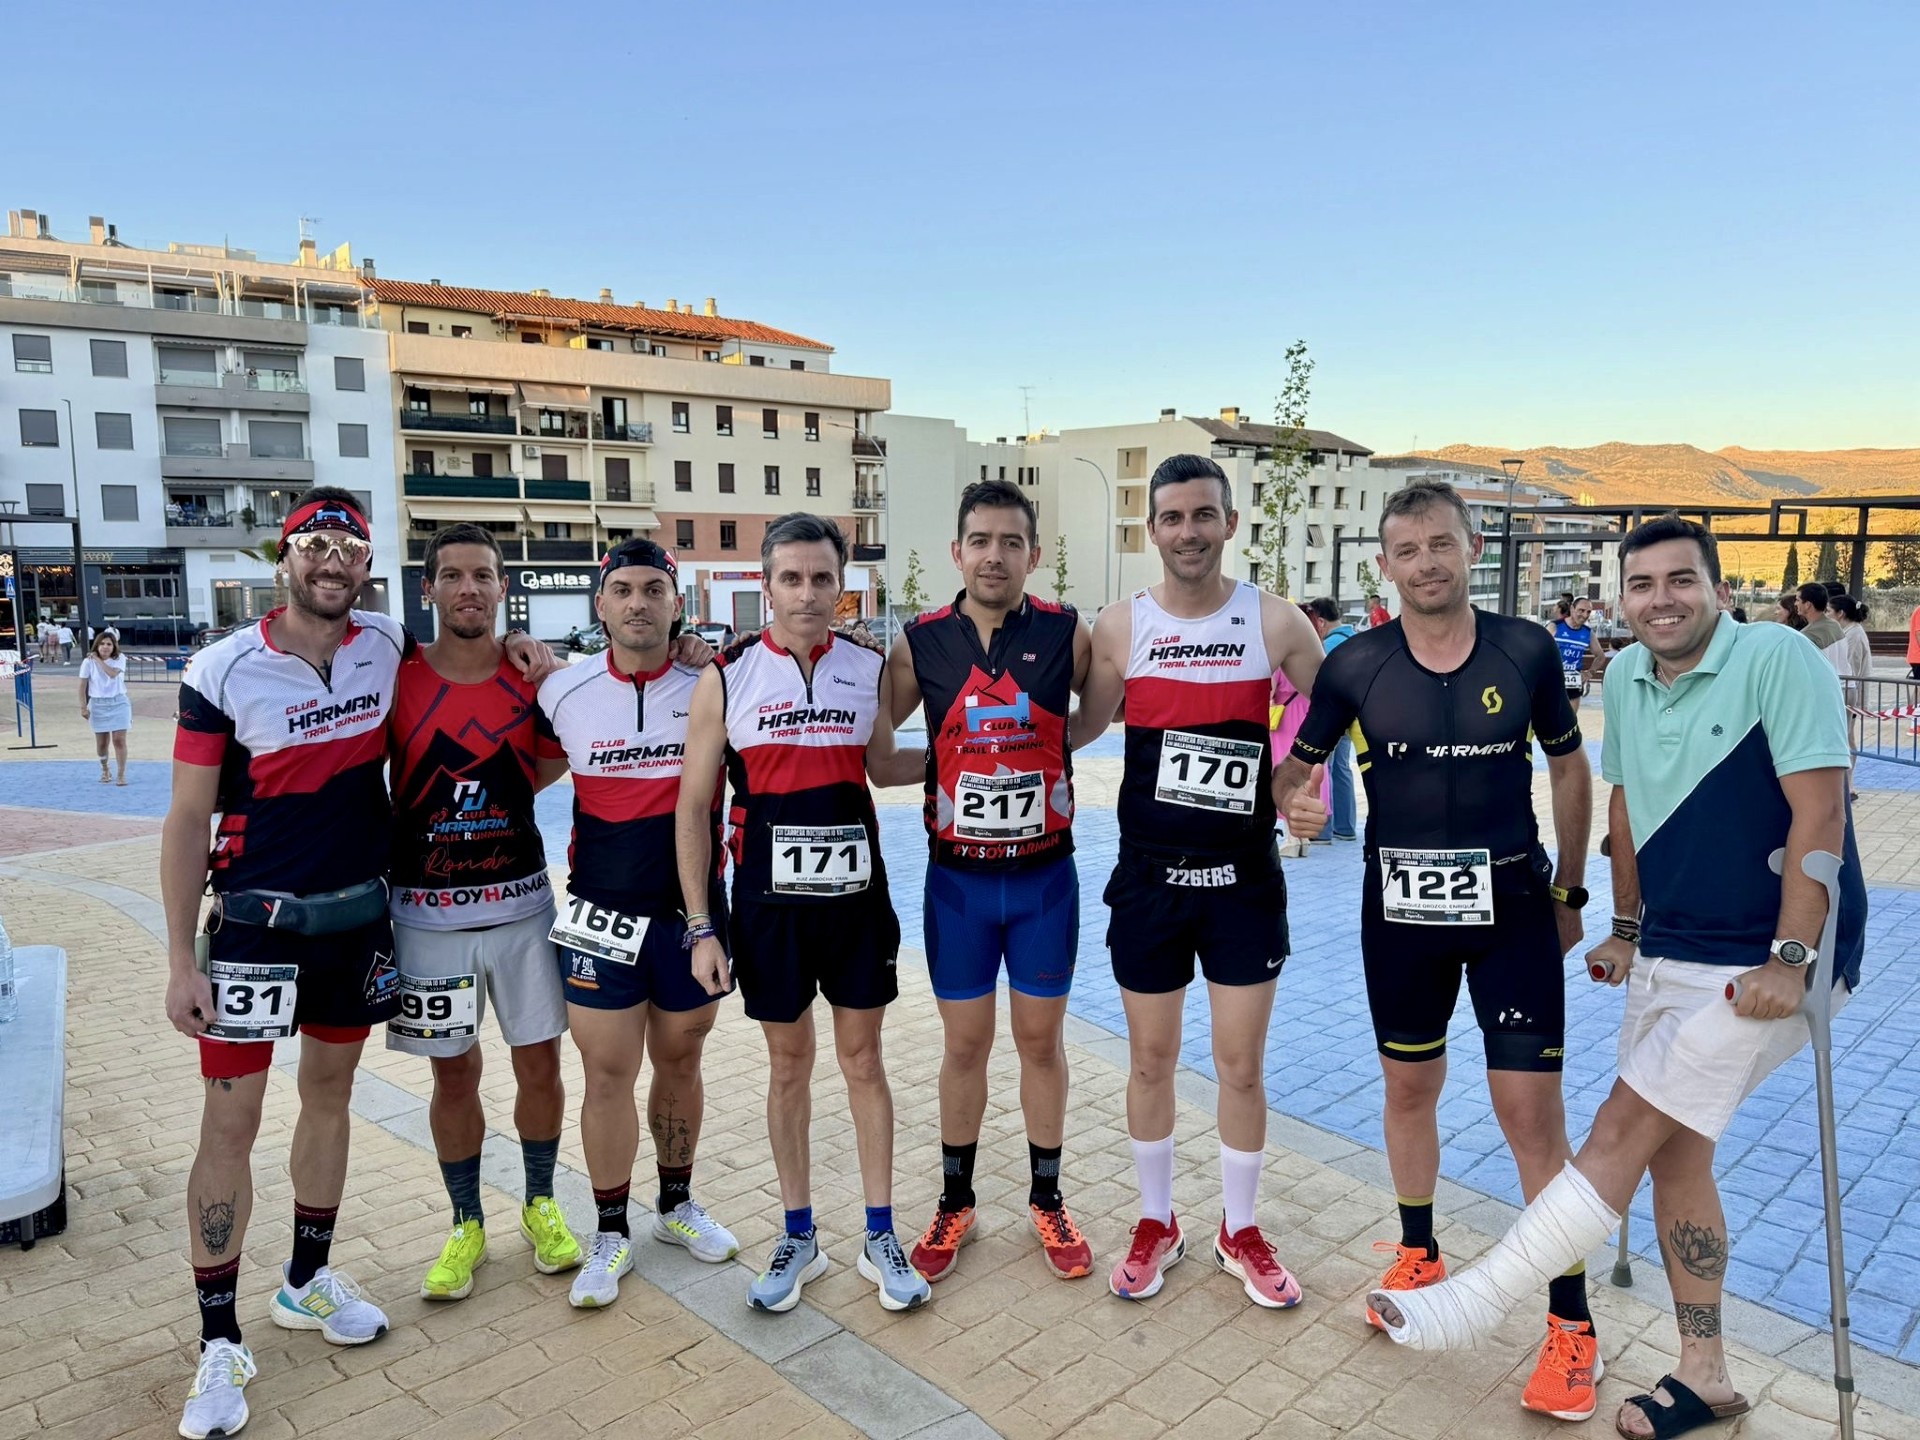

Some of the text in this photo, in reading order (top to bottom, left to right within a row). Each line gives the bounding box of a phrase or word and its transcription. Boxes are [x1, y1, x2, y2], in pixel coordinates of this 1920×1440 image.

[540, 572, 592, 586] atlas
[1152, 636, 1180, 646] CLUB
[1149, 644, 1246, 661] HARMAN
[1158, 661, 1187, 669] TRAIL
[286, 699, 318, 715] CLUB
[288, 692, 380, 733] HARMAN
[759, 701, 793, 713] CLUB
[303, 709, 380, 739] TRAIL RUNNING
[758, 708, 856, 731] HARMAN
[983, 722, 1014, 731] CLUB
[770, 726, 854, 738] TRAIL RUNNING
[591, 739, 625, 748] CLUB
[956, 741, 1044, 754] TRAIL RUNNING
[1296, 737, 1327, 754] SCOTT
[600, 763, 635, 773] TRAIL
[1170, 753, 1248, 789] 170
[963, 790, 1036, 819] 217
[455, 811, 486, 820] CLUB
[434, 818, 508, 832] HARMAN
[427, 829, 514, 842] TRAIL RUNNING
[953, 833, 1060, 859] #YOSOYHARMAN
[422, 846, 517, 876] Ronda
[782, 845, 857, 873] 171
[1390, 851, 1411, 860] CARRERA
[1165, 864, 1237, 888] 226ERS
[401, 871, 550, 907] #YOSOYHARMAN
[1391, 870, 1478, 900] 122
[569, 898, 638, 940] 166
[402, 994, 452, 1020] 99
